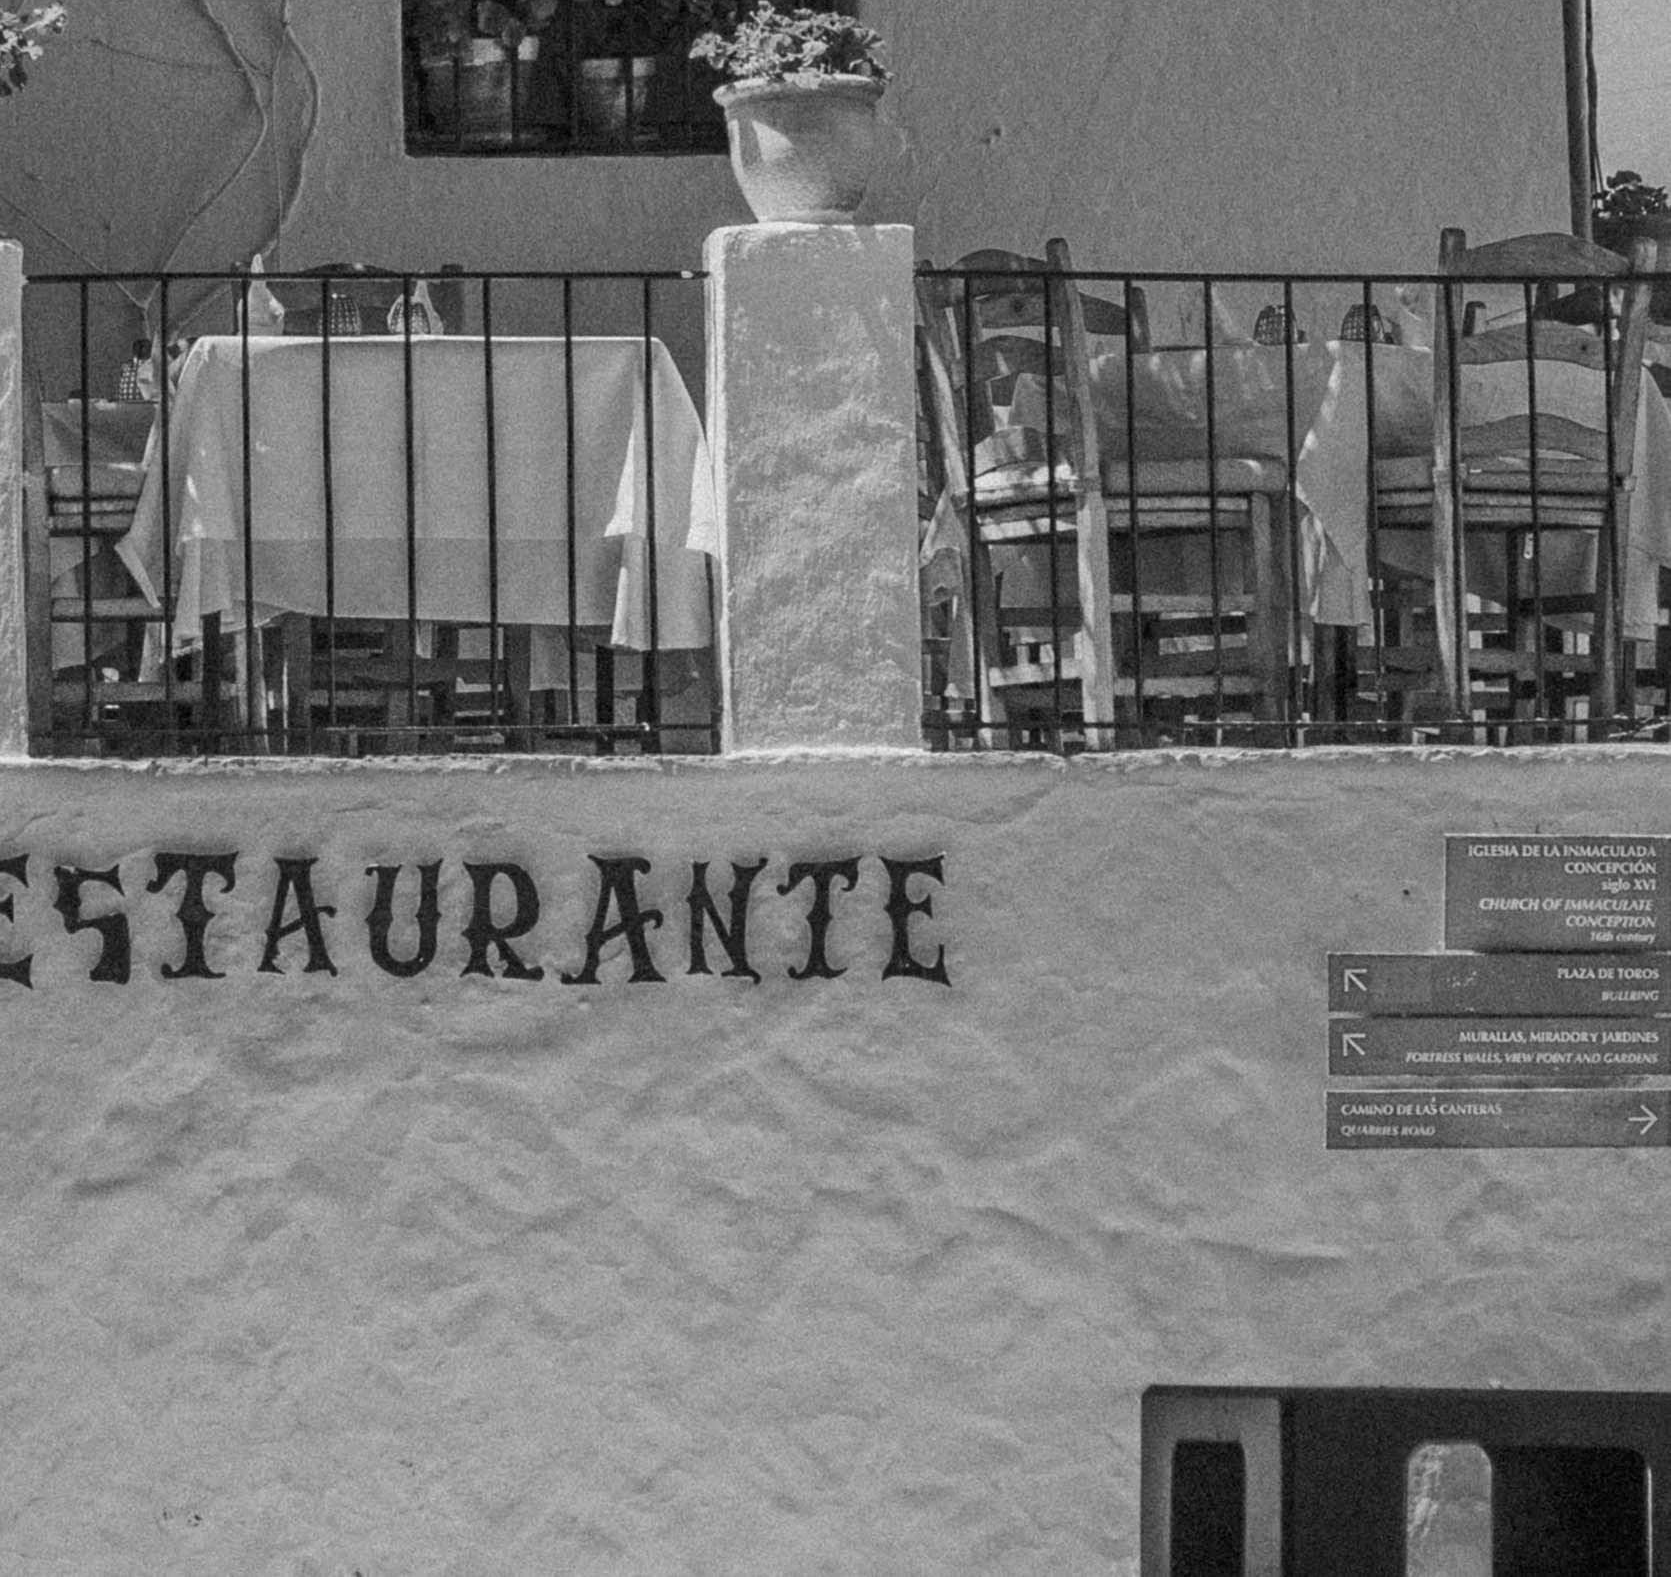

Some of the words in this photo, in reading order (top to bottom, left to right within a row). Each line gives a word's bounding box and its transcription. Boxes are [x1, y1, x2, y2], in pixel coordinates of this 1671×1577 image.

[1468, 845, 1519, 857] IGLESIA
[1522, 845, 1541, 857] DE
[1544, 845, 1560, 857] LA
[1563, 845, 1657, 857] INMACULADA
[1564, 859, 1657, 874] CONCEPCIÓN
[1602, 877, 1631, 893] siglo
[1633, 879, 1657, 891] XVI
[1479, 898, 1540, 911] CHURCH
[1542, 898, 1563, 911] OF
[1564, 898, 1654, 911] IMMACULATE
[1566, 915, 1658, 928] CONCEPTION
[1557, 968, 1596, 979] PLAZA
[1598, 968, 1615, 979] DE
[1617, 968, 1660, 979] TOROS
[1529, 1031, 1589, 1043] MIRADOR
[1589, 1032, 1598, 1043] Y
[1601, 1031, 1660, 1044] JARDINES
[1405, 1052, 1461, 1064] FORTRESS
[1504, 1052, 1536, 1064] VIEW
[1536, 1052, 1572, 1064] POINT
[1574, 1052, 1601, 1064] AND
[1603, 1052, 1659, 1064] GARDENS
[1340, 1104, 1395, 1116] CAMINO
[1396, 1104, 1414, 1116] DE
[1415, 1104, 1438, 1116] LAS
[1439, 1104, 1503, 1116] CANTERAS
